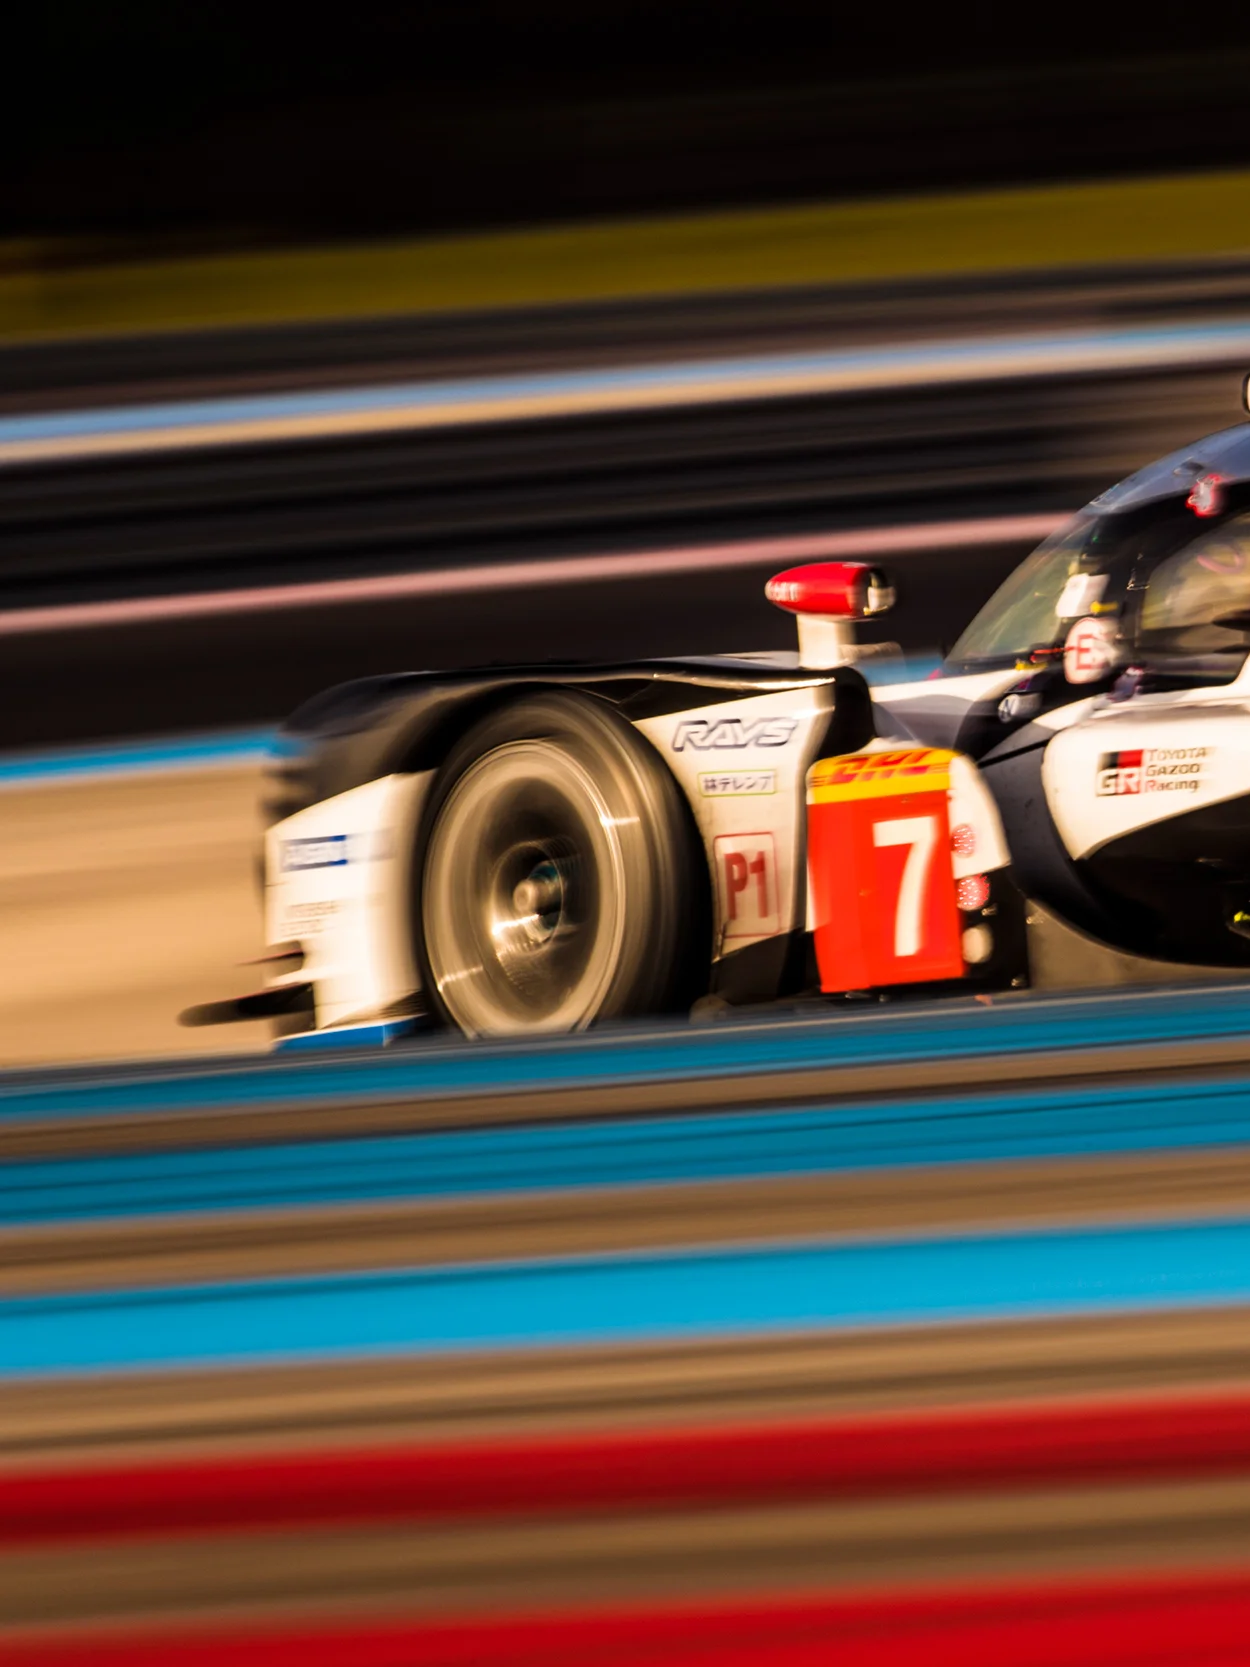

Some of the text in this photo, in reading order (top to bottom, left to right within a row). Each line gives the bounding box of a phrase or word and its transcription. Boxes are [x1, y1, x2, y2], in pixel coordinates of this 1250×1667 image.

[673, 717, 798, 752] RAYS
[829, 750, 932, 785] DHL
[1145, 747, 1207, 762] TOYOTA
[1145, 763, 1201, 777] GAZOO
[1098, 767, 1141, 796] GR
[1144, 779, 1200, 794] Racing
[724, 850, 768, 920] P1
[872, 815, 939, 957] 7
